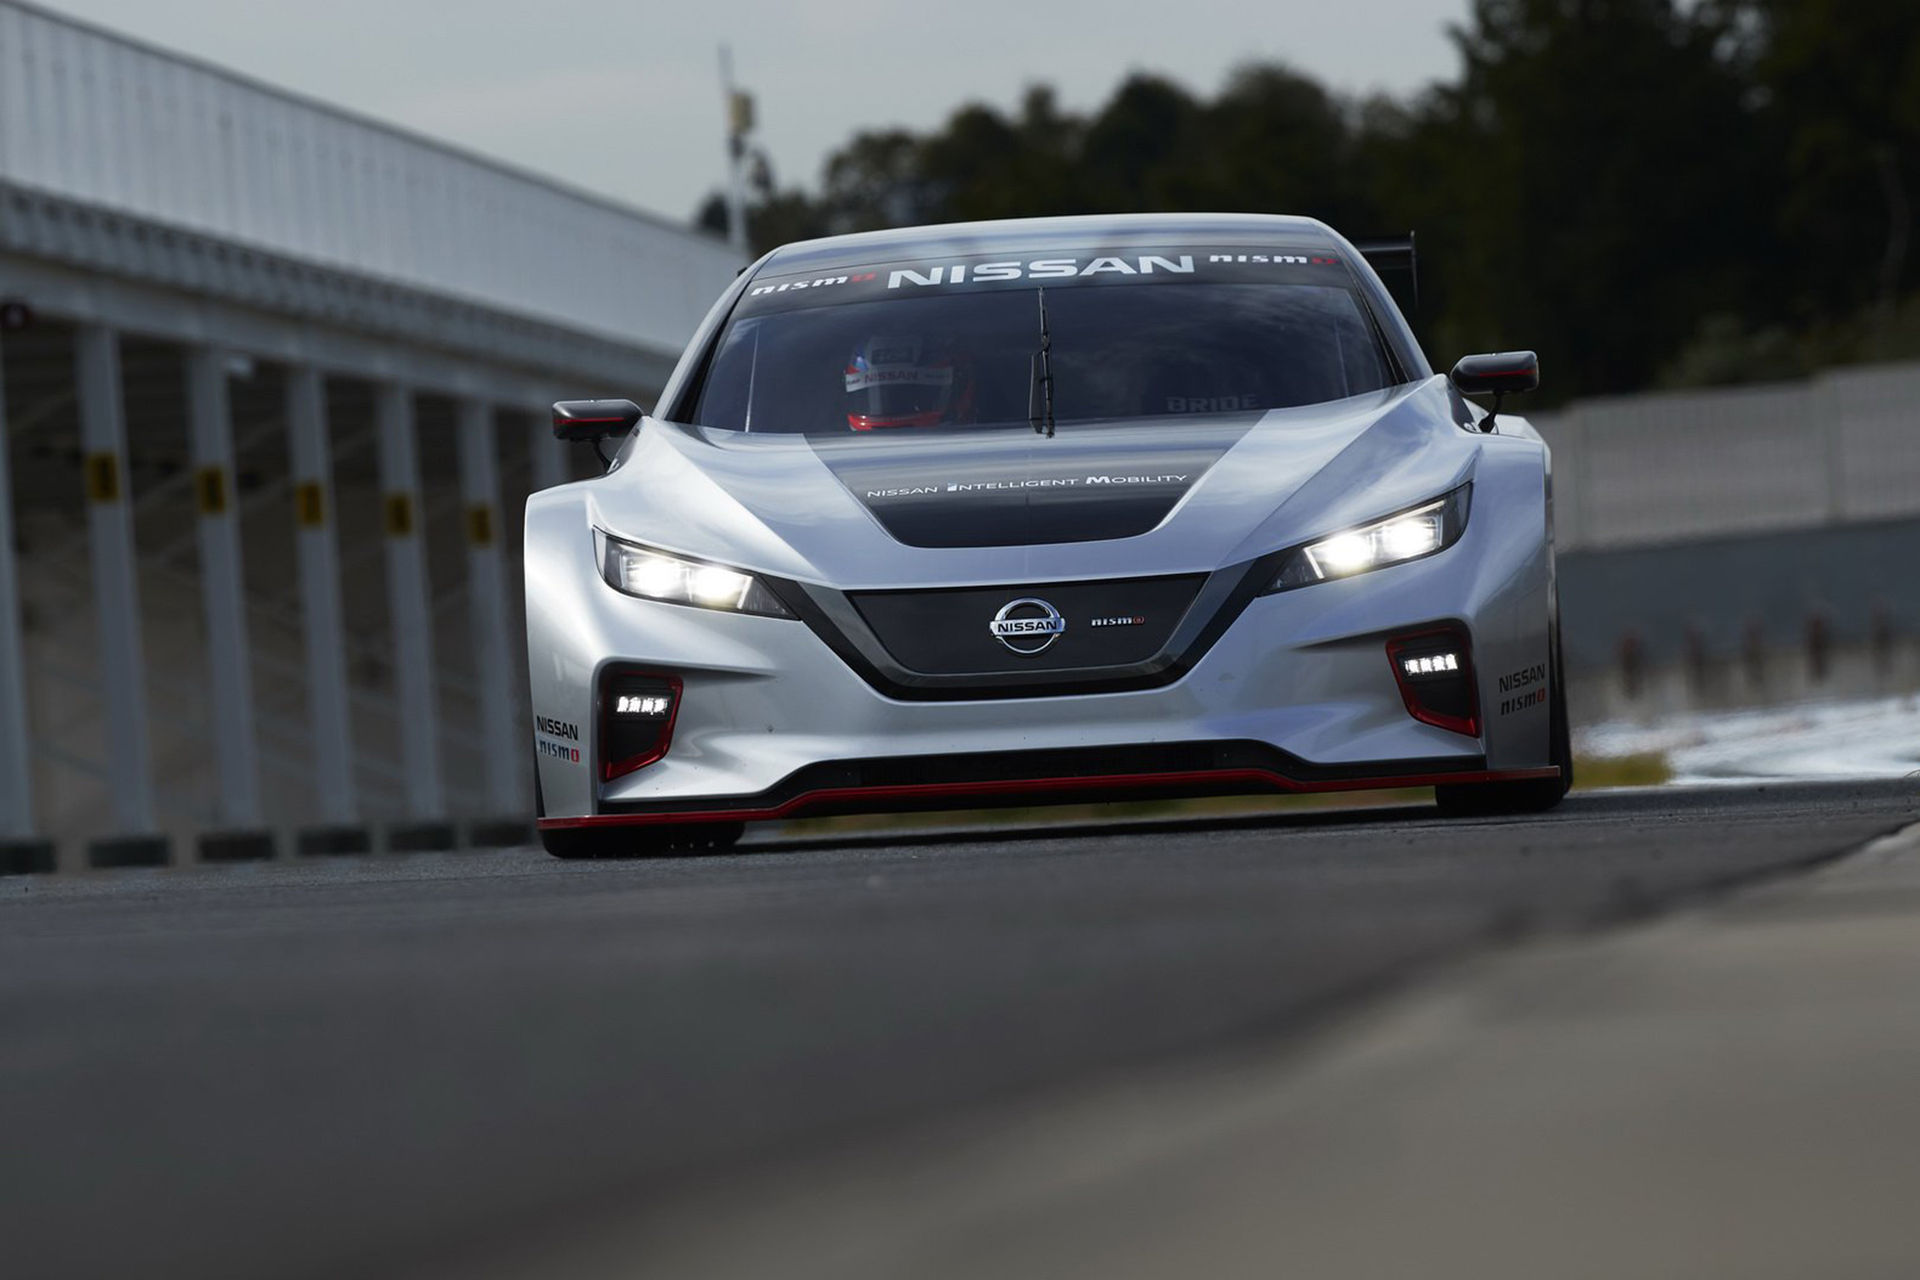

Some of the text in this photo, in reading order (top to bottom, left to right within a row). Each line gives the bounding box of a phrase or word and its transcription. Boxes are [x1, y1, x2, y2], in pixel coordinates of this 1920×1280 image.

[887, 254, 1195, 289] NISSAN
[1165, 393, 1259, 412] BRIDE
[867, 486, 938, 497] NISSAN
[997, 620, 1058, 633] NISSAN
[1499, 663, 1546, 693] NISSAN
[536, 714, 578, 741] NISSAN
